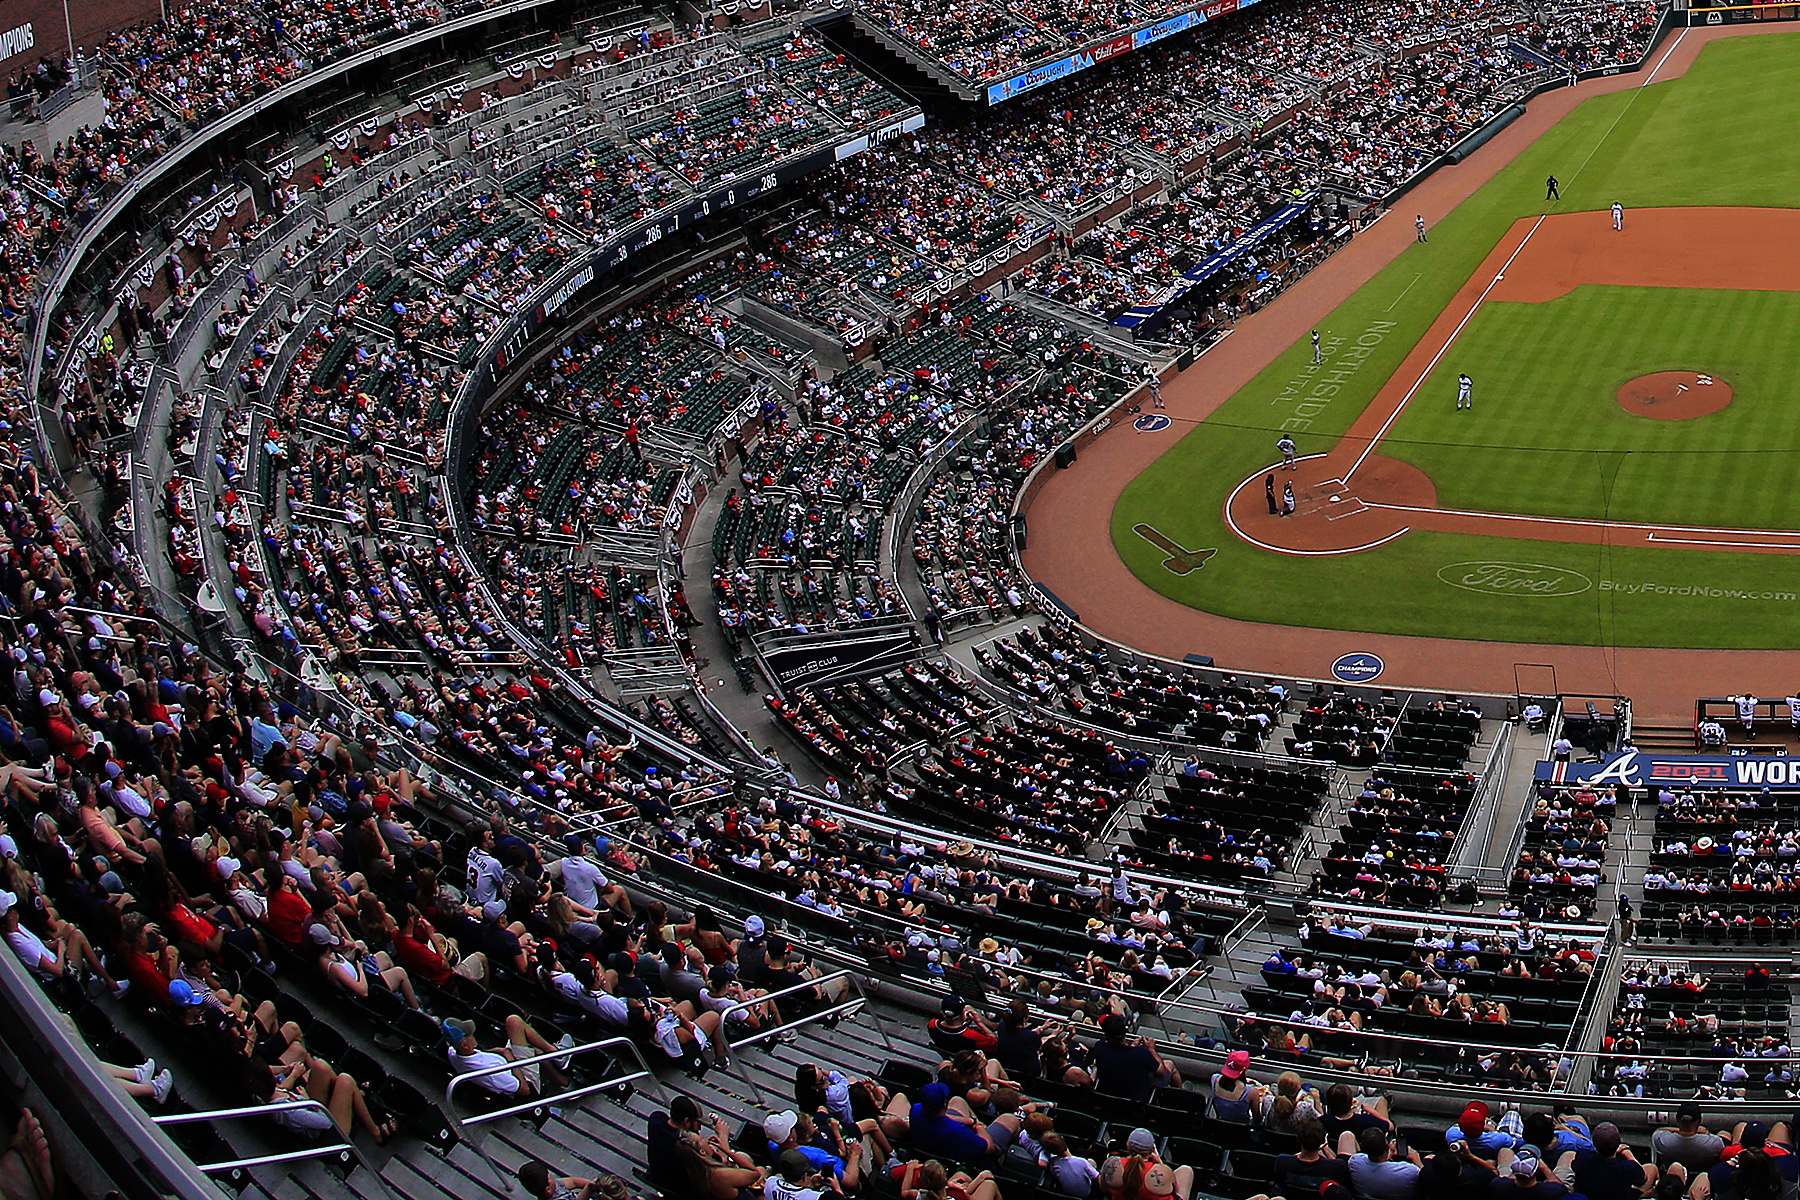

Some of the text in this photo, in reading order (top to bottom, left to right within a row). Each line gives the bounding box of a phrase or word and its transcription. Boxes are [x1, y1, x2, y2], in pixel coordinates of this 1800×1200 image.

[868, 121, 904, 149] Miami
[760, 173, 777, 191] .286
[728, 190, 735, 205] 0
[703, 200, 709, 215] 0
[674, 215, 679, 230] 7
[645, 224, 662, 246] .286
[1280, 320, 1397, 432] NORTHSIDE
[1461, 565, 1797, 601] Ford BuyFordNow.com
[1337, 665, 1377, 673] CHAMPIONS
[1651, 765, 1727, 778] 2021
